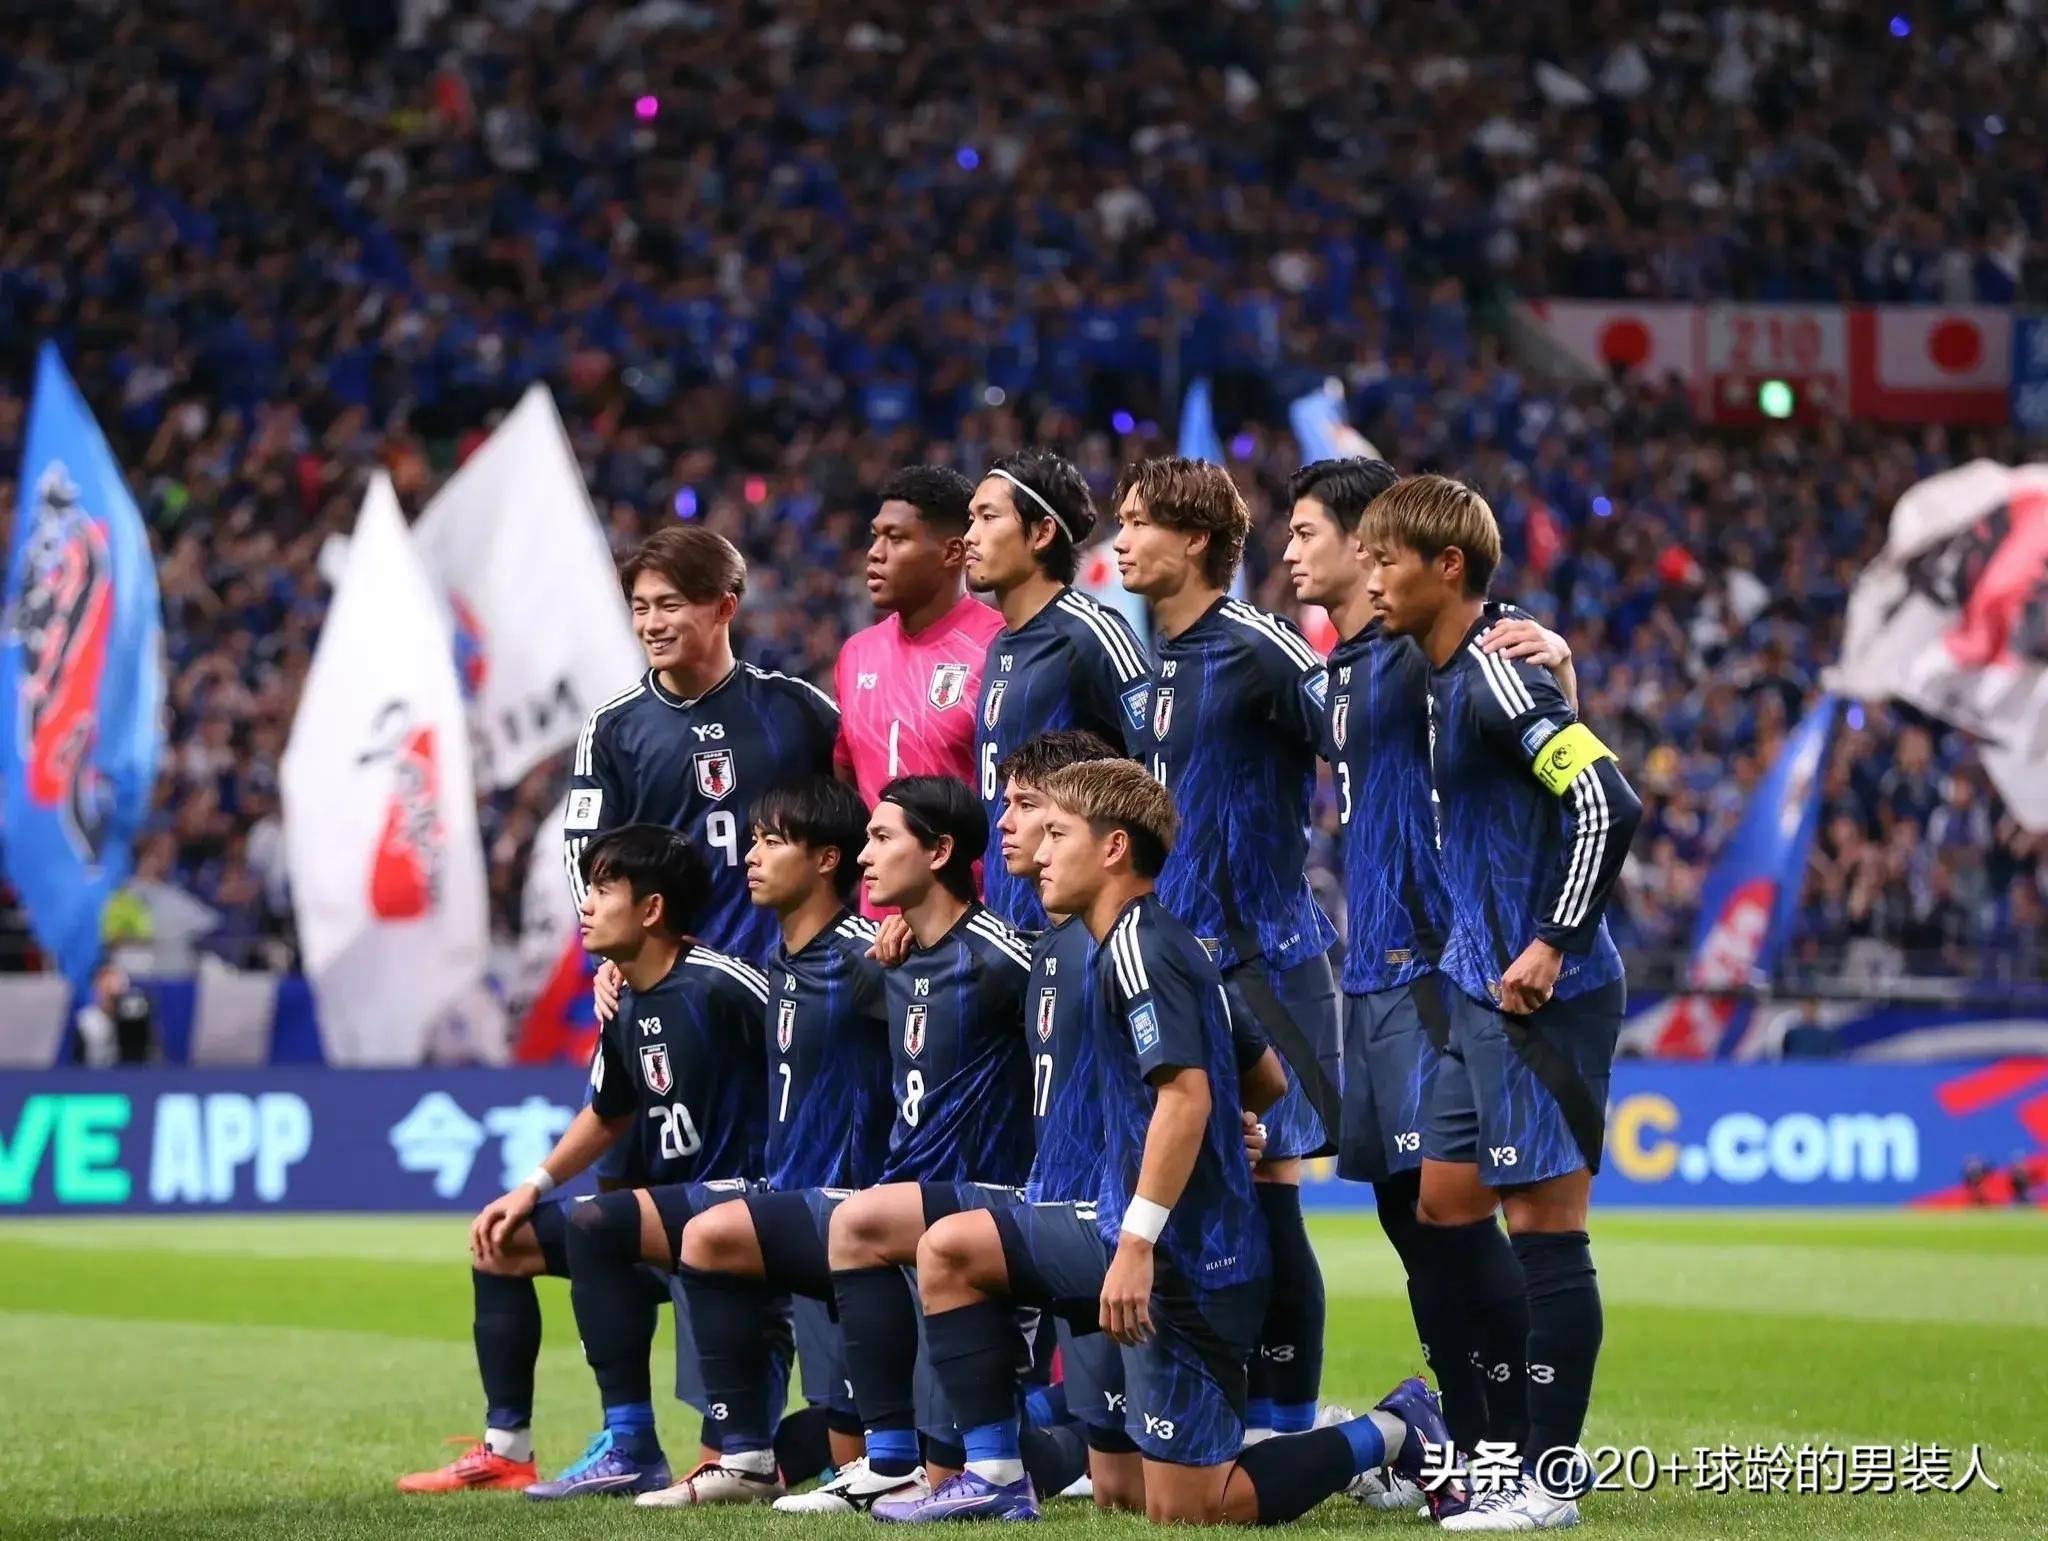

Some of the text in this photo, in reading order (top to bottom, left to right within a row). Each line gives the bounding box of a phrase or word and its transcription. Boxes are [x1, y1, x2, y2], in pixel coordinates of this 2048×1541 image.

[981, 742, 998, 801] 16
[1337, 761, 1352, 825] 3
[706, 810, 738, 867] 9
[779, 1062, 792, 1122] 7
[902, 1069, 925, 1127] 8
[1033, 1053, 1053, 1117] 17
[149, 1092, 312, 1204] APP
[648, 1102, 702, 1160] 20
